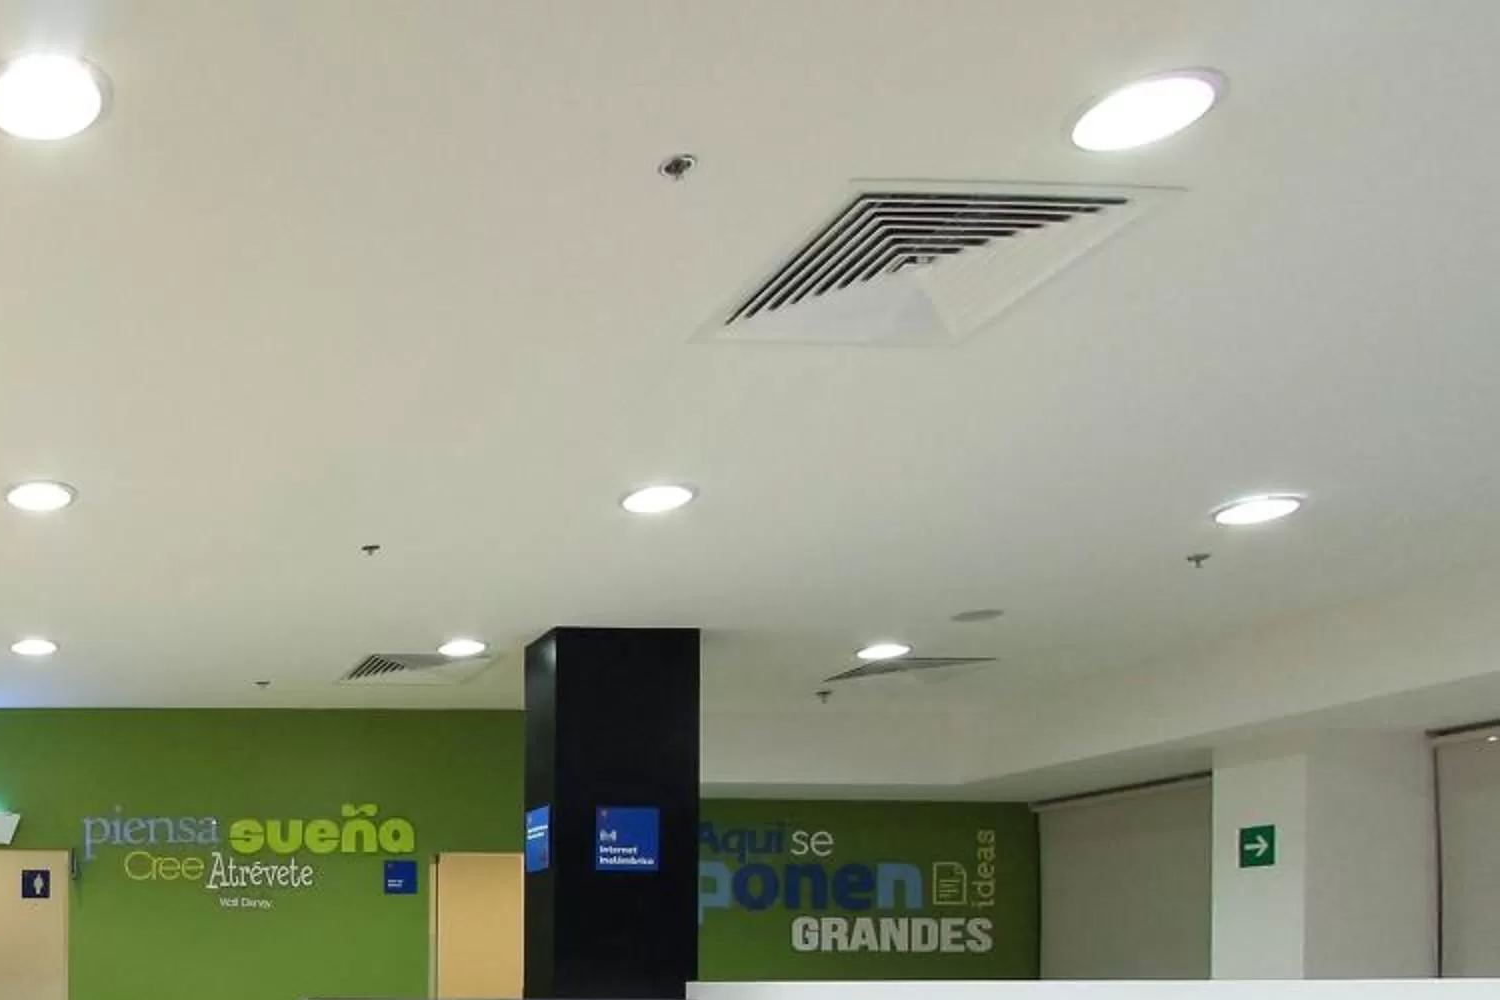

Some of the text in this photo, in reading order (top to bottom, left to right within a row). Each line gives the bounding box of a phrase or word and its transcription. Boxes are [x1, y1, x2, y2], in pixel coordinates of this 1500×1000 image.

[83, 803, 415, 861] piensa sueña
[791, 830, 835, 857] se
[123, 851, 314, 890] Cree Atrévete
[971, 829, 996, 909] ideas
[791, 916, 994, 953] GRANDES
